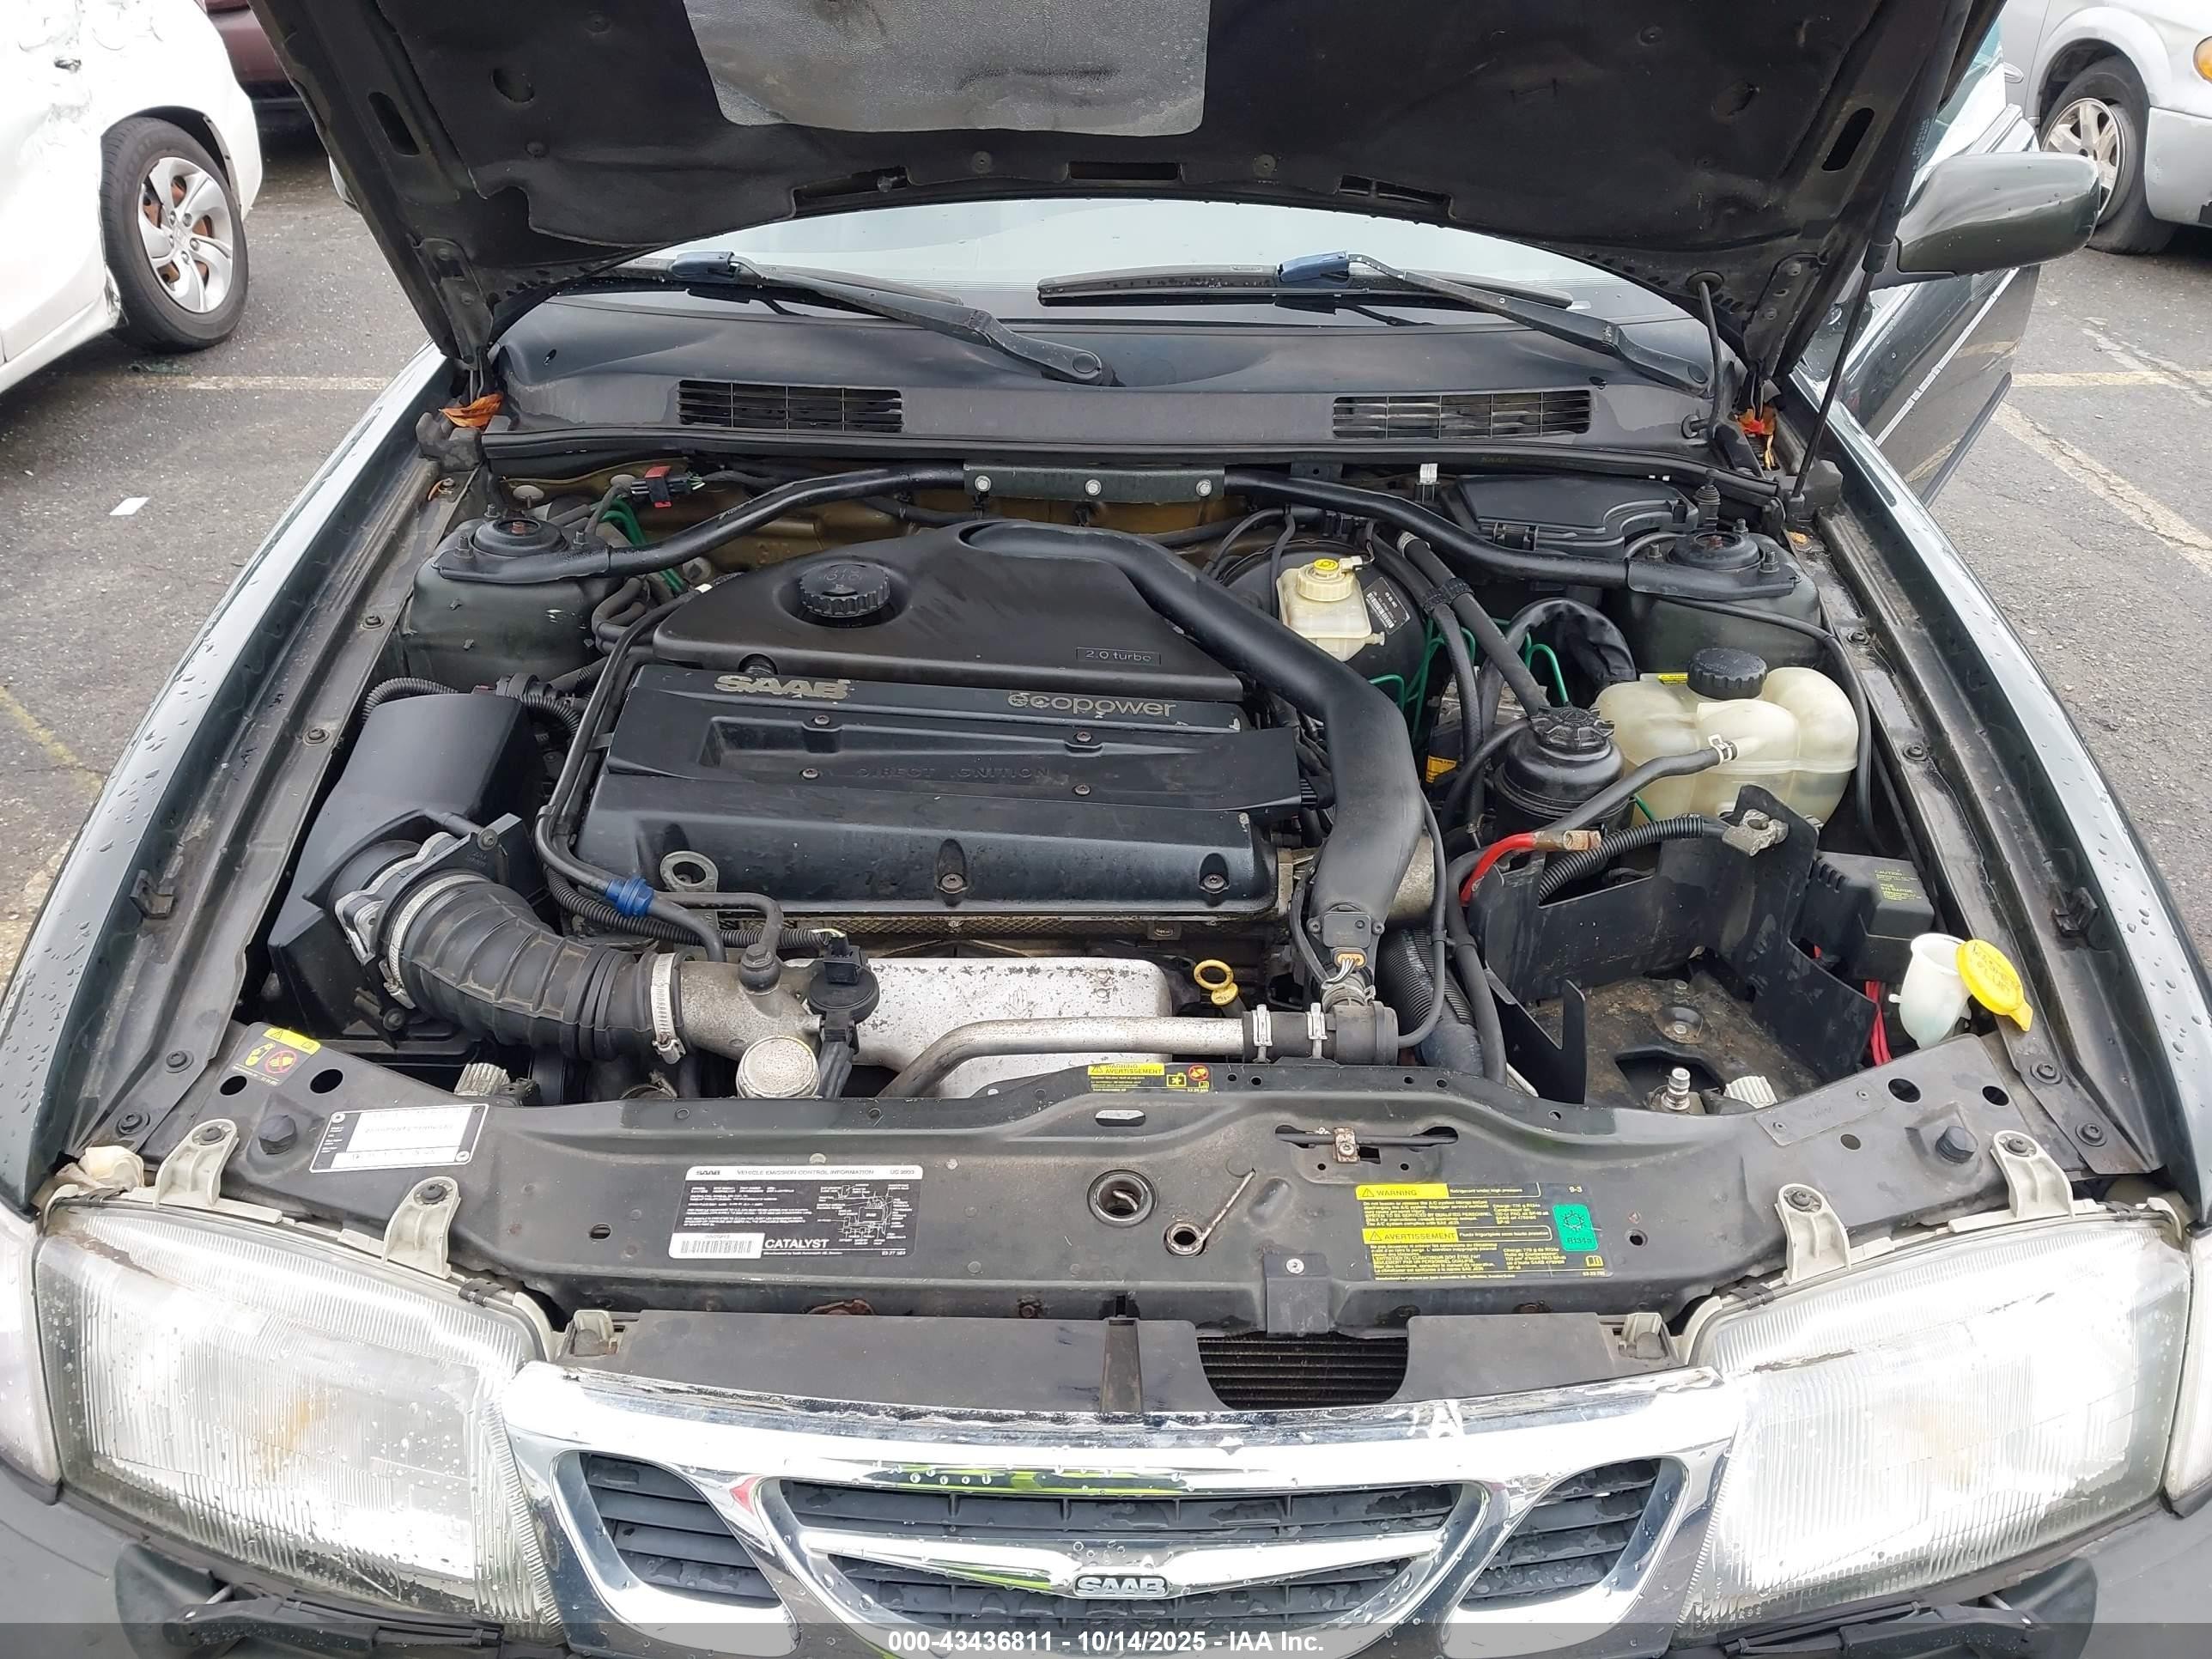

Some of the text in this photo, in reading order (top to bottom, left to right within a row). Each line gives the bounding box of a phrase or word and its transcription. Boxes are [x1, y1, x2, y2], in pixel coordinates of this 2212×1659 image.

[1085, 650, 1152, 662] 2.0 turbo
[714, 675, 848, 700] SAAB
[1007, 693, 1176, 718] ecopower
[764, 1239, 830, 1249] CATALYST
[1077, 1577, 1165, 1595] SAAB
